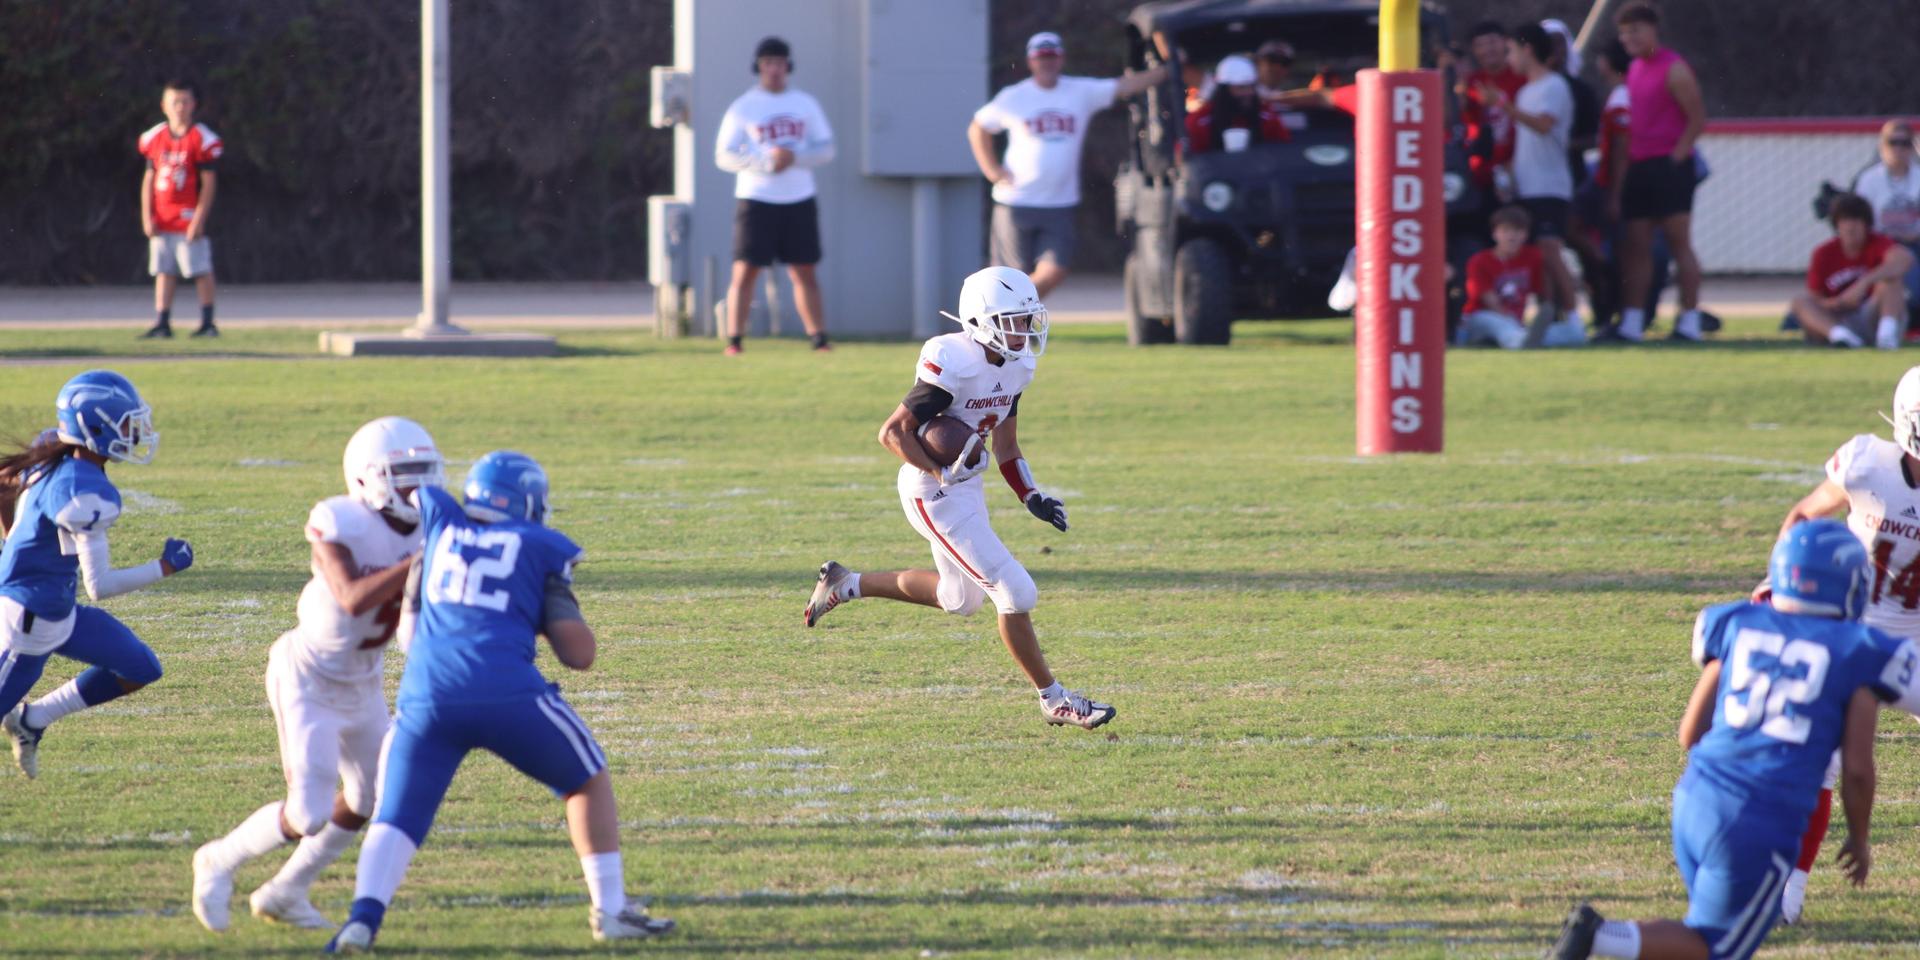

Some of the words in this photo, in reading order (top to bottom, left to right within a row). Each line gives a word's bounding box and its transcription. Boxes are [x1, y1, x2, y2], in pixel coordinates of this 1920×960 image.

[1390, 86, 1424, 434] REDSKINS
[964, 394, 1014, 410] CHOWCHILL
[82, 510, 101, 531] 1
[426, 523, 522, 613] 62
[1871, 539, 1920, 610] 14
[1724, 627, 1830, 745] 52
